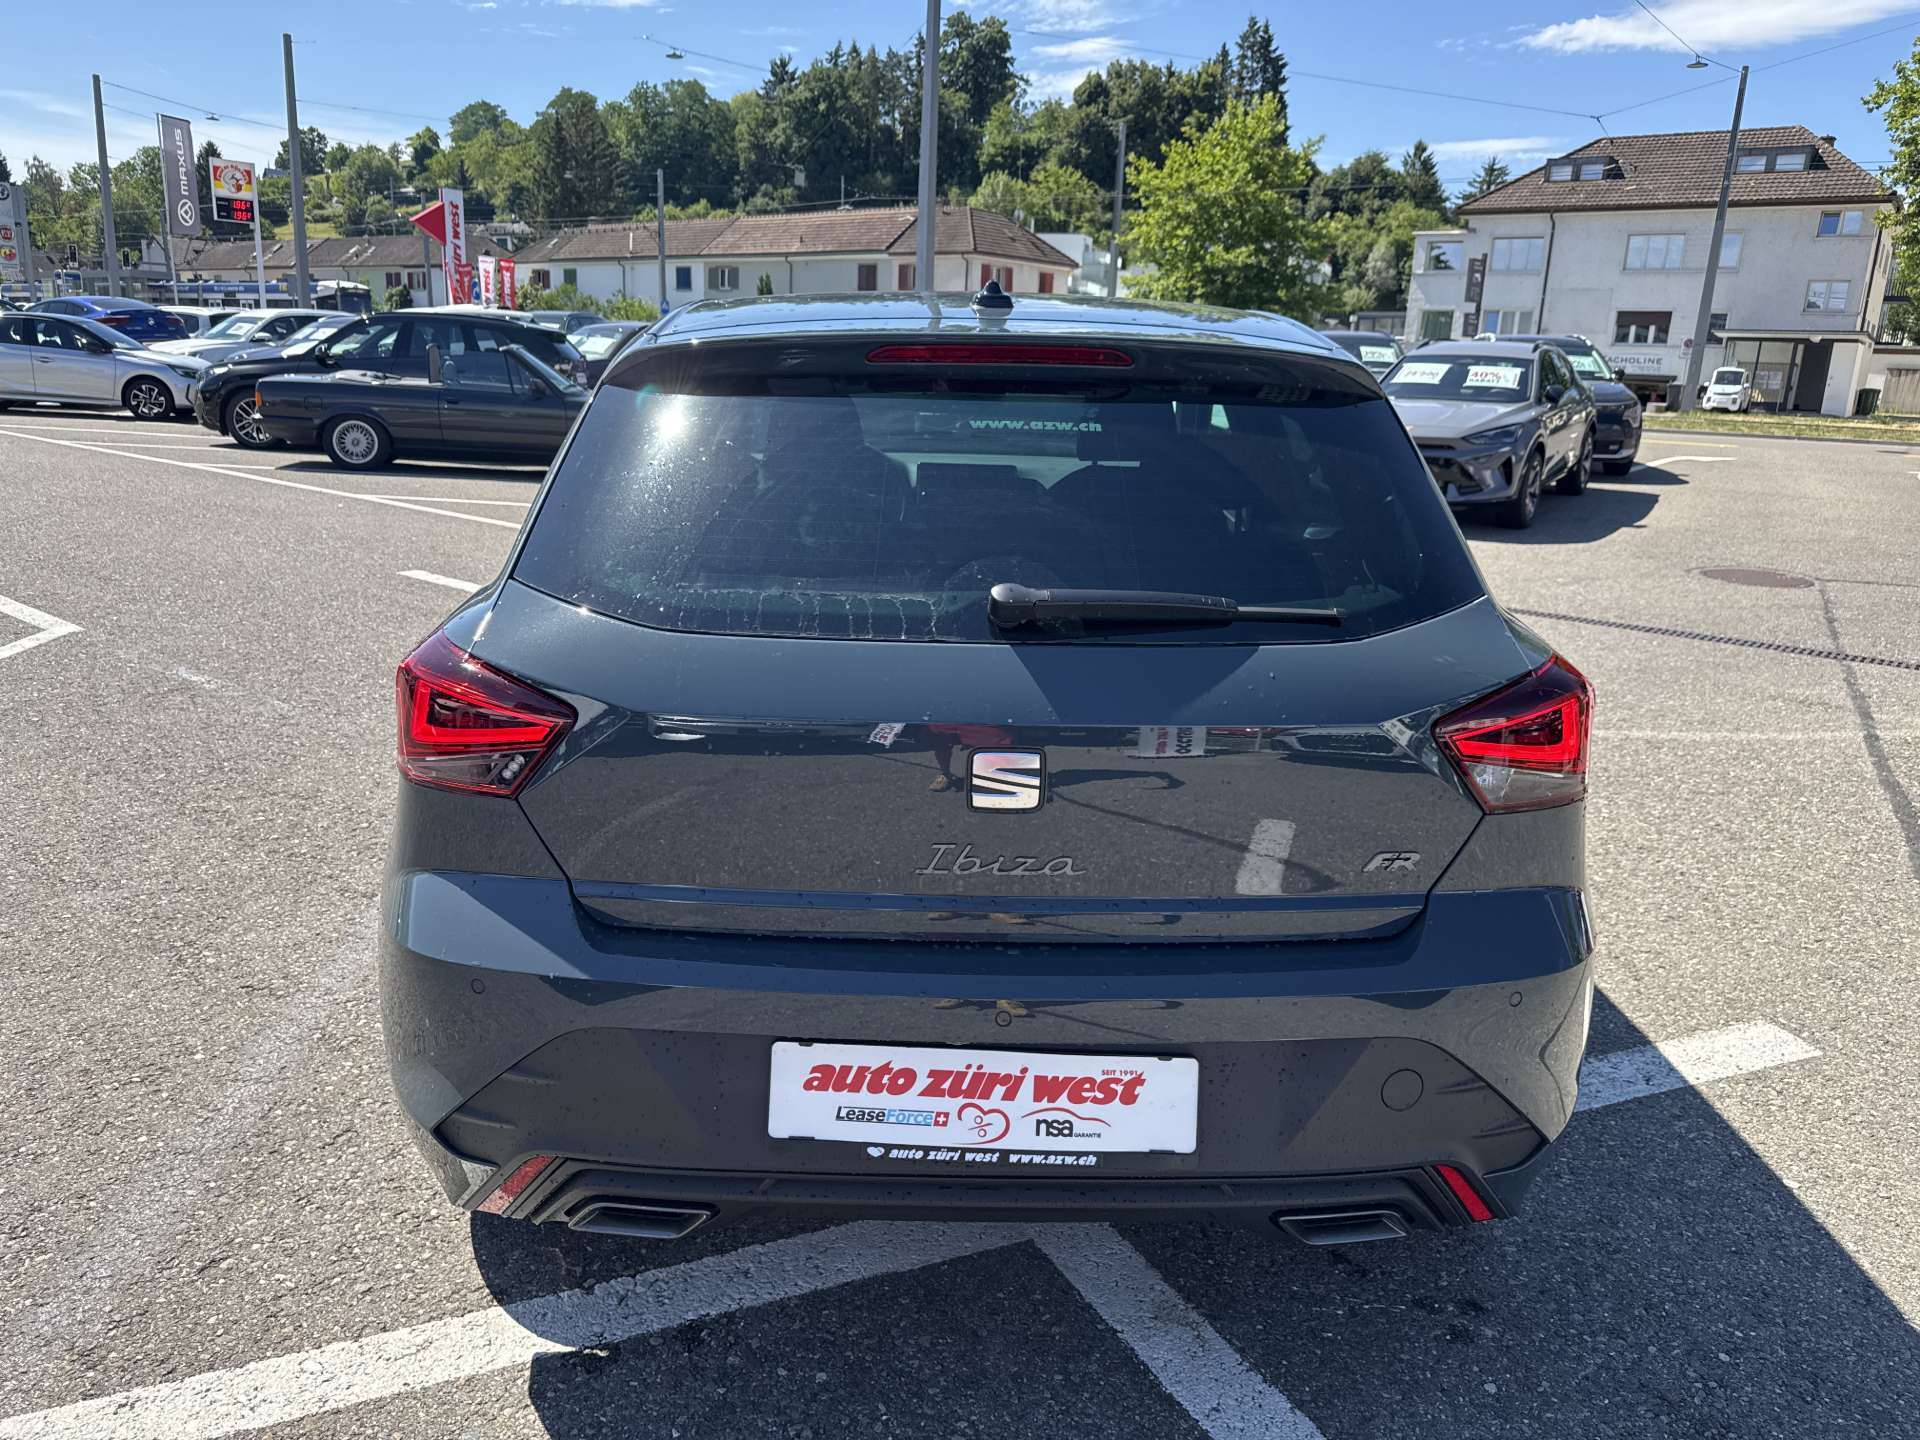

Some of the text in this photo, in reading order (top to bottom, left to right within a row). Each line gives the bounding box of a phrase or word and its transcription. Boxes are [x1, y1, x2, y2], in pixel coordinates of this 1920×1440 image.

[175, 128, 189, 195] MAXUS
[914, 843, 1087, 876] Ibiza
[1361, 851, 1421, 872] FR
[802, 1060, 1147, 1106] auto züri west
[835, 1106, 934, 1125] LeaseForce
[1035, 1118, 1074, 1138] nsa
[889, 1149, 925, 1160] auto
[964, 1151, 1000, 1163] west
[1008, 1153, 1098, 1166] www.azw.ch
